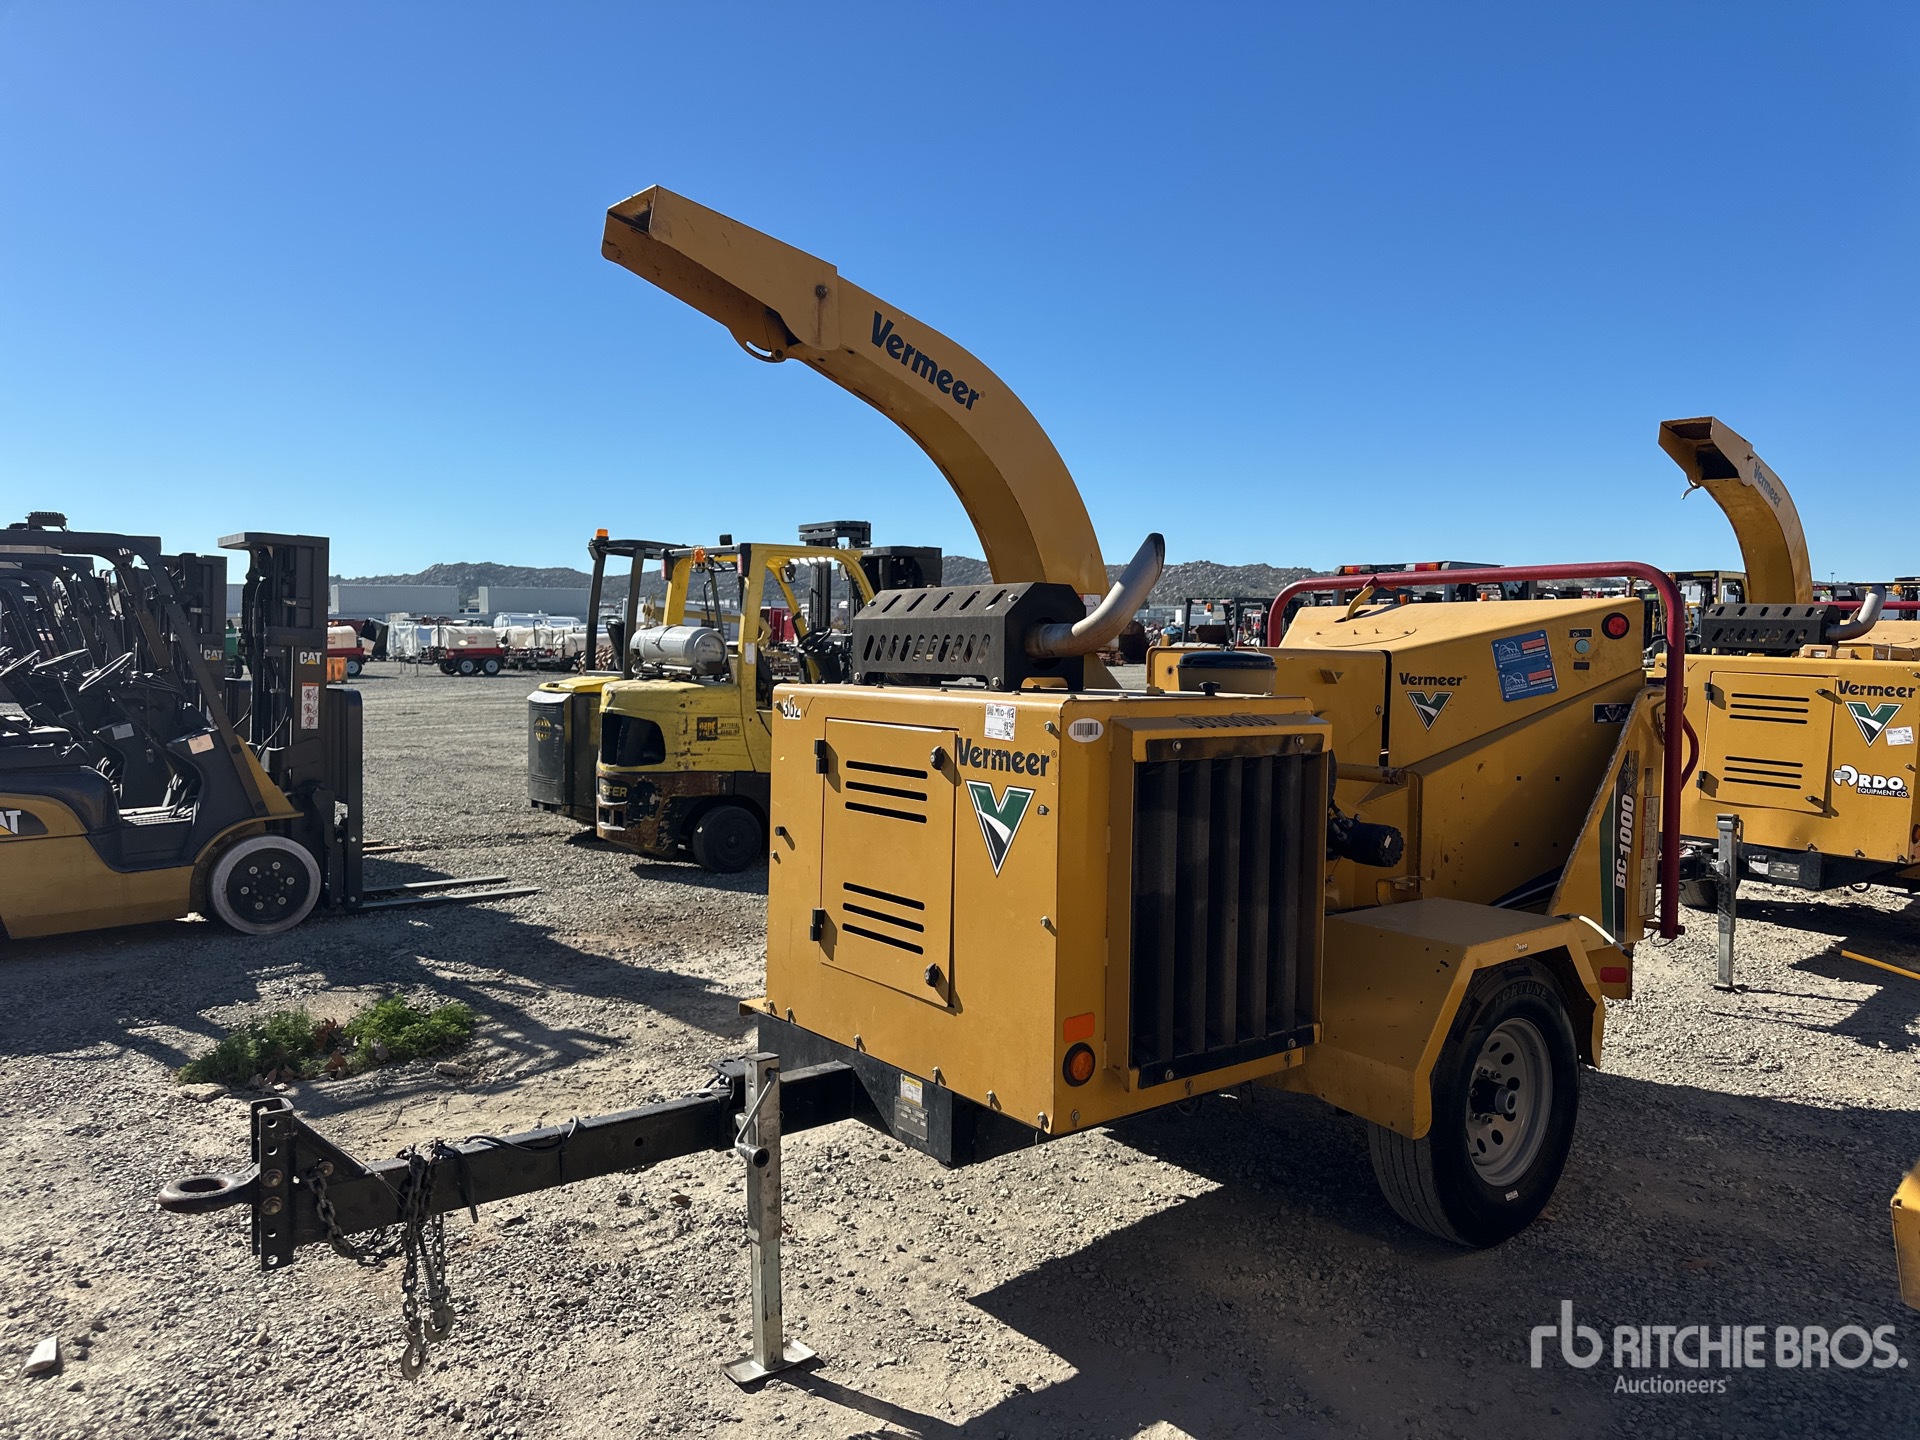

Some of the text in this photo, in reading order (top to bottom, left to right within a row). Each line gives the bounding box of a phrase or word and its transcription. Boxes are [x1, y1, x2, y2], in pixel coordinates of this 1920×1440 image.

[872, 310, 980, 411] Vermeer
[204, 649, 223, 660] CAT
[300, 651, 322, 665] CAT
[1399, 672, 1463, 686] Vermeer
[1837, 680, 1916, 699] Vermeer
[957, 738, 1050, 777] Vermeer
[1857, 787, 1896, 796] EQUIPMENT
[1495, 981, 1549, 1007] FORTUNE
